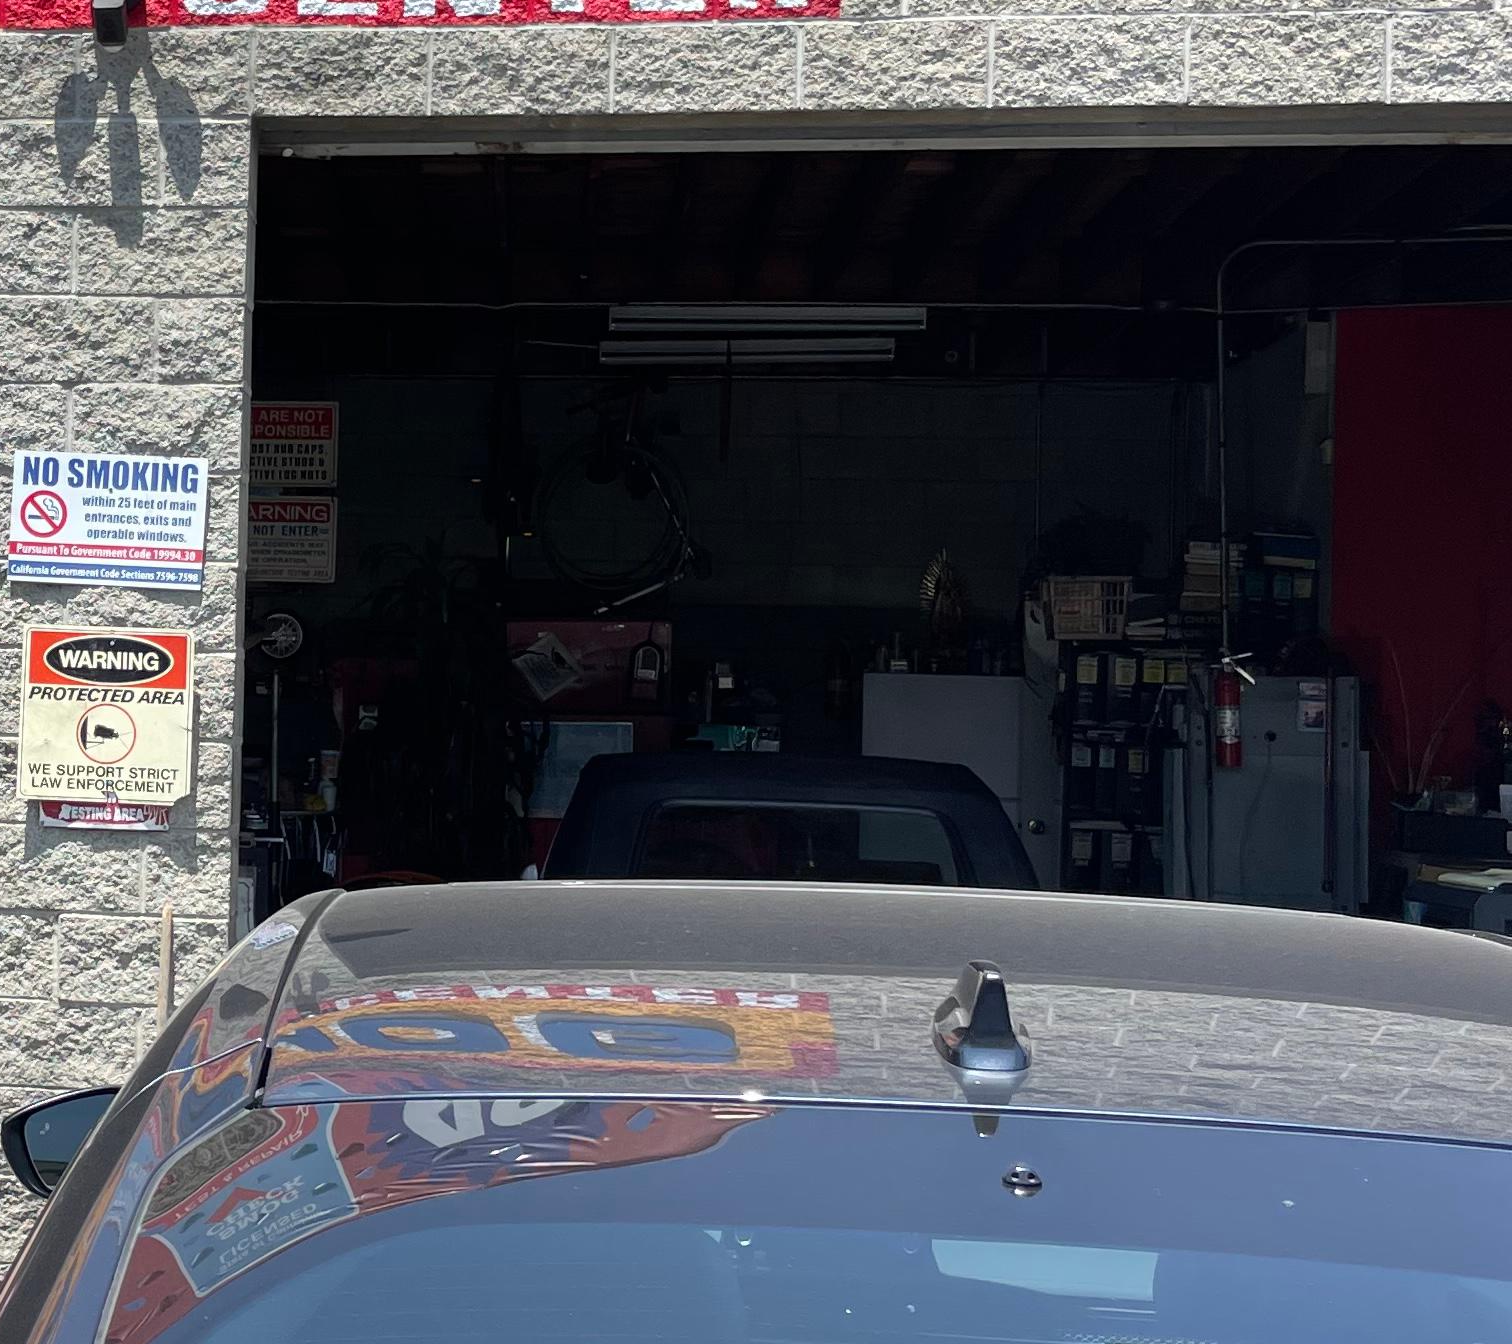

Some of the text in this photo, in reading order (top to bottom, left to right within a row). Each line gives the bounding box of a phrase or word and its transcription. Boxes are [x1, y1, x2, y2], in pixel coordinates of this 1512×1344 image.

[258, 409, 326, 423] ARE NOT
[252, 424, 332, 438] PONSIBLE
[250, 443, 270, 454] OST
[249, 456, 278, 467] CTIVE
[22, 456, 200, 494] NO SMOKING
[249, 470, 275, 481] TIVE
[82, 496, 197, 512] within 25 feet of main
[248, 503, 329, 521] ARNING
[84, 513, 192, 527] entrances, exits and
[86, 528, 187, 543] operable windows.
[253, 525, 319, 536] NOT ENTER
[16, 542, 58, 555] Pursuant
[58, 545, 70, 555] To
[71, 545, 128, 558] Government
[129, 548, 152, 559] Code
[10, 563, 49, 575] California
[50, 565, 99, 577] Government
[100, 568, 120, 578] Code
[121, 569, 155, 580] Sections
[58, 649, 160, 672] WARNING
[28, 686, 185, 705] PROTECTED AREA
[28, 763, 179, 781] WE SUPPORT STRICT
[31, 776, 175, 794] LAW ENFORCEMENT
[114, 806, 145, 822] AREA
